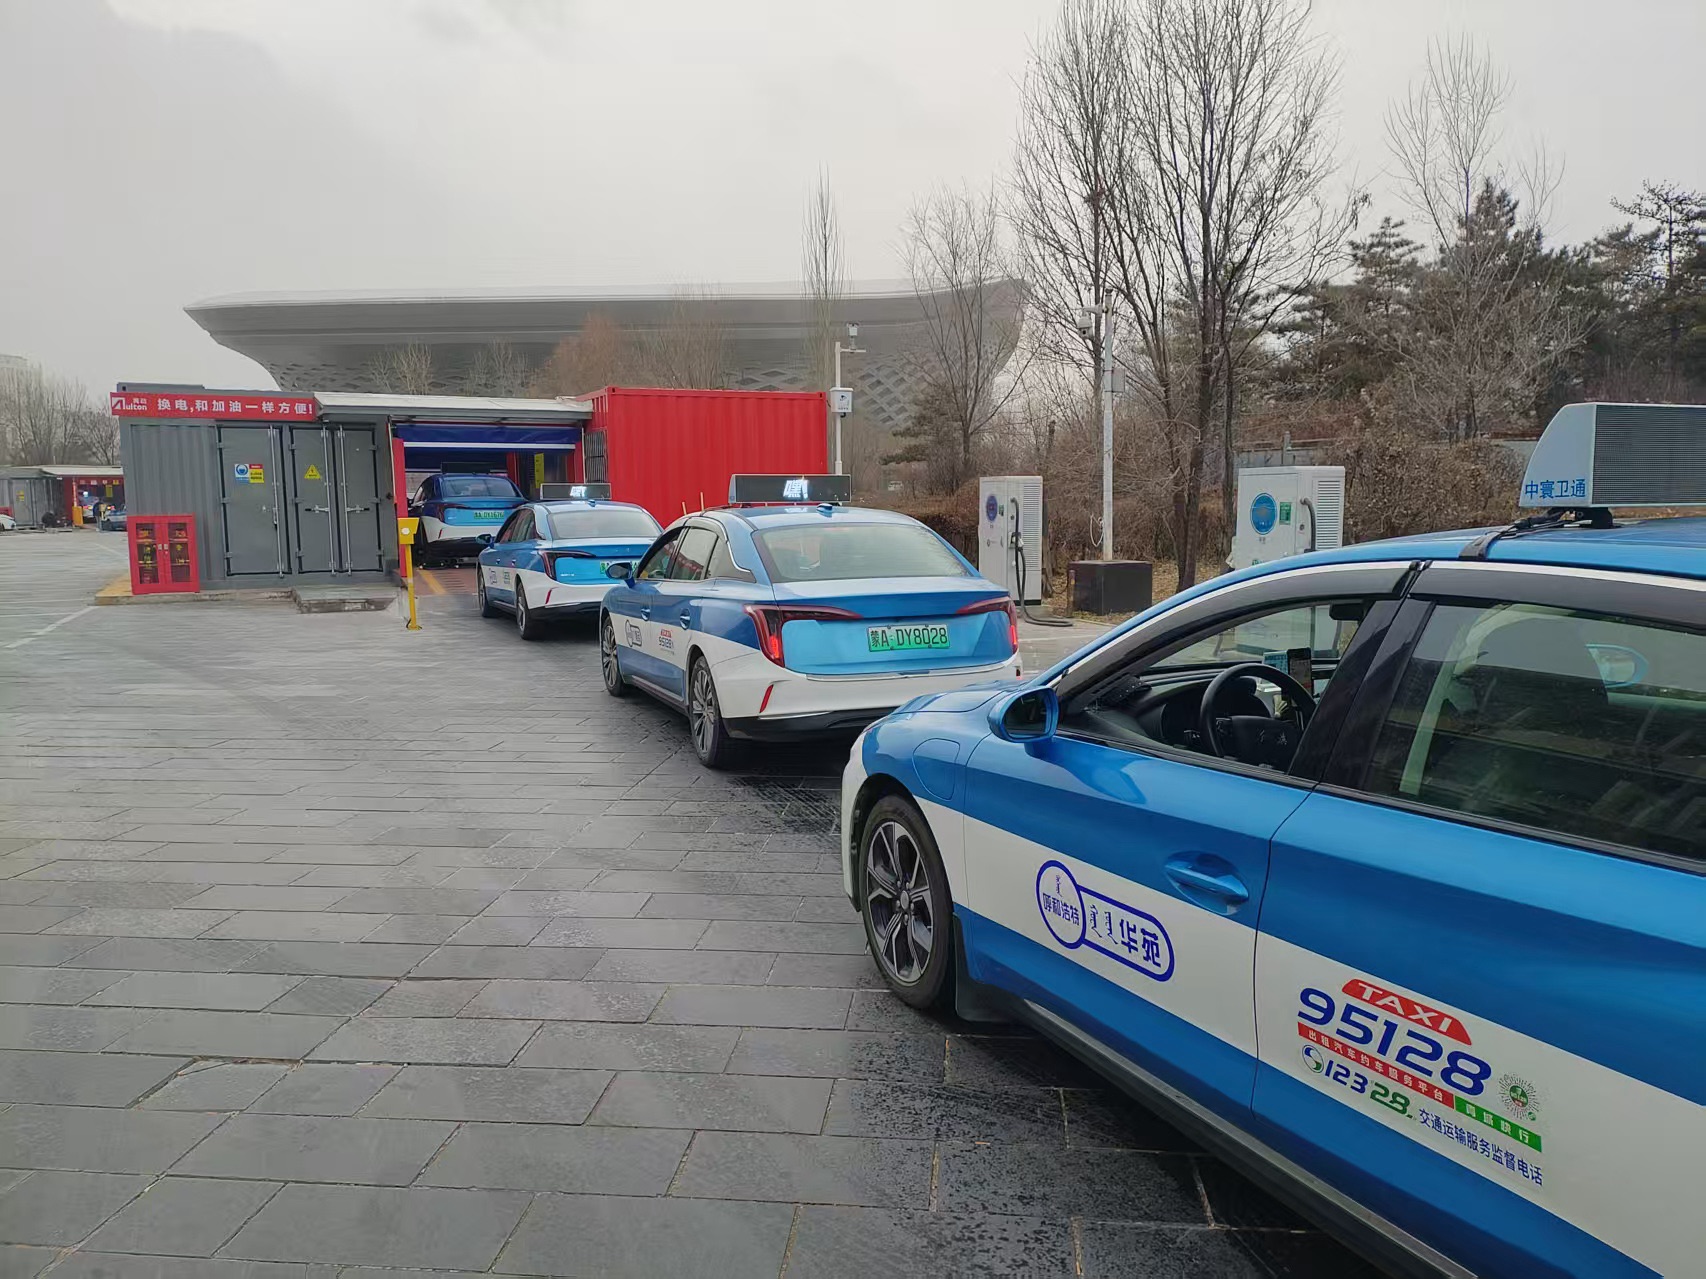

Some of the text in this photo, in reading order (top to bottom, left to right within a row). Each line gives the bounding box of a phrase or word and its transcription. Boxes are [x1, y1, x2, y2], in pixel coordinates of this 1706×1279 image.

[1525, 478, 1586, 499] 中寰卫通
[1119, 918, 1162, 968] 华苑
[1356, 982, 1454, 1033] TAXI
[1297, 987, 1492, 1096] 95128
[1308, 1029, 1444, 1102] 出租汽车约车服务平台
[1418, 1107, 1544, 1187] 交通运输服务监督电话
